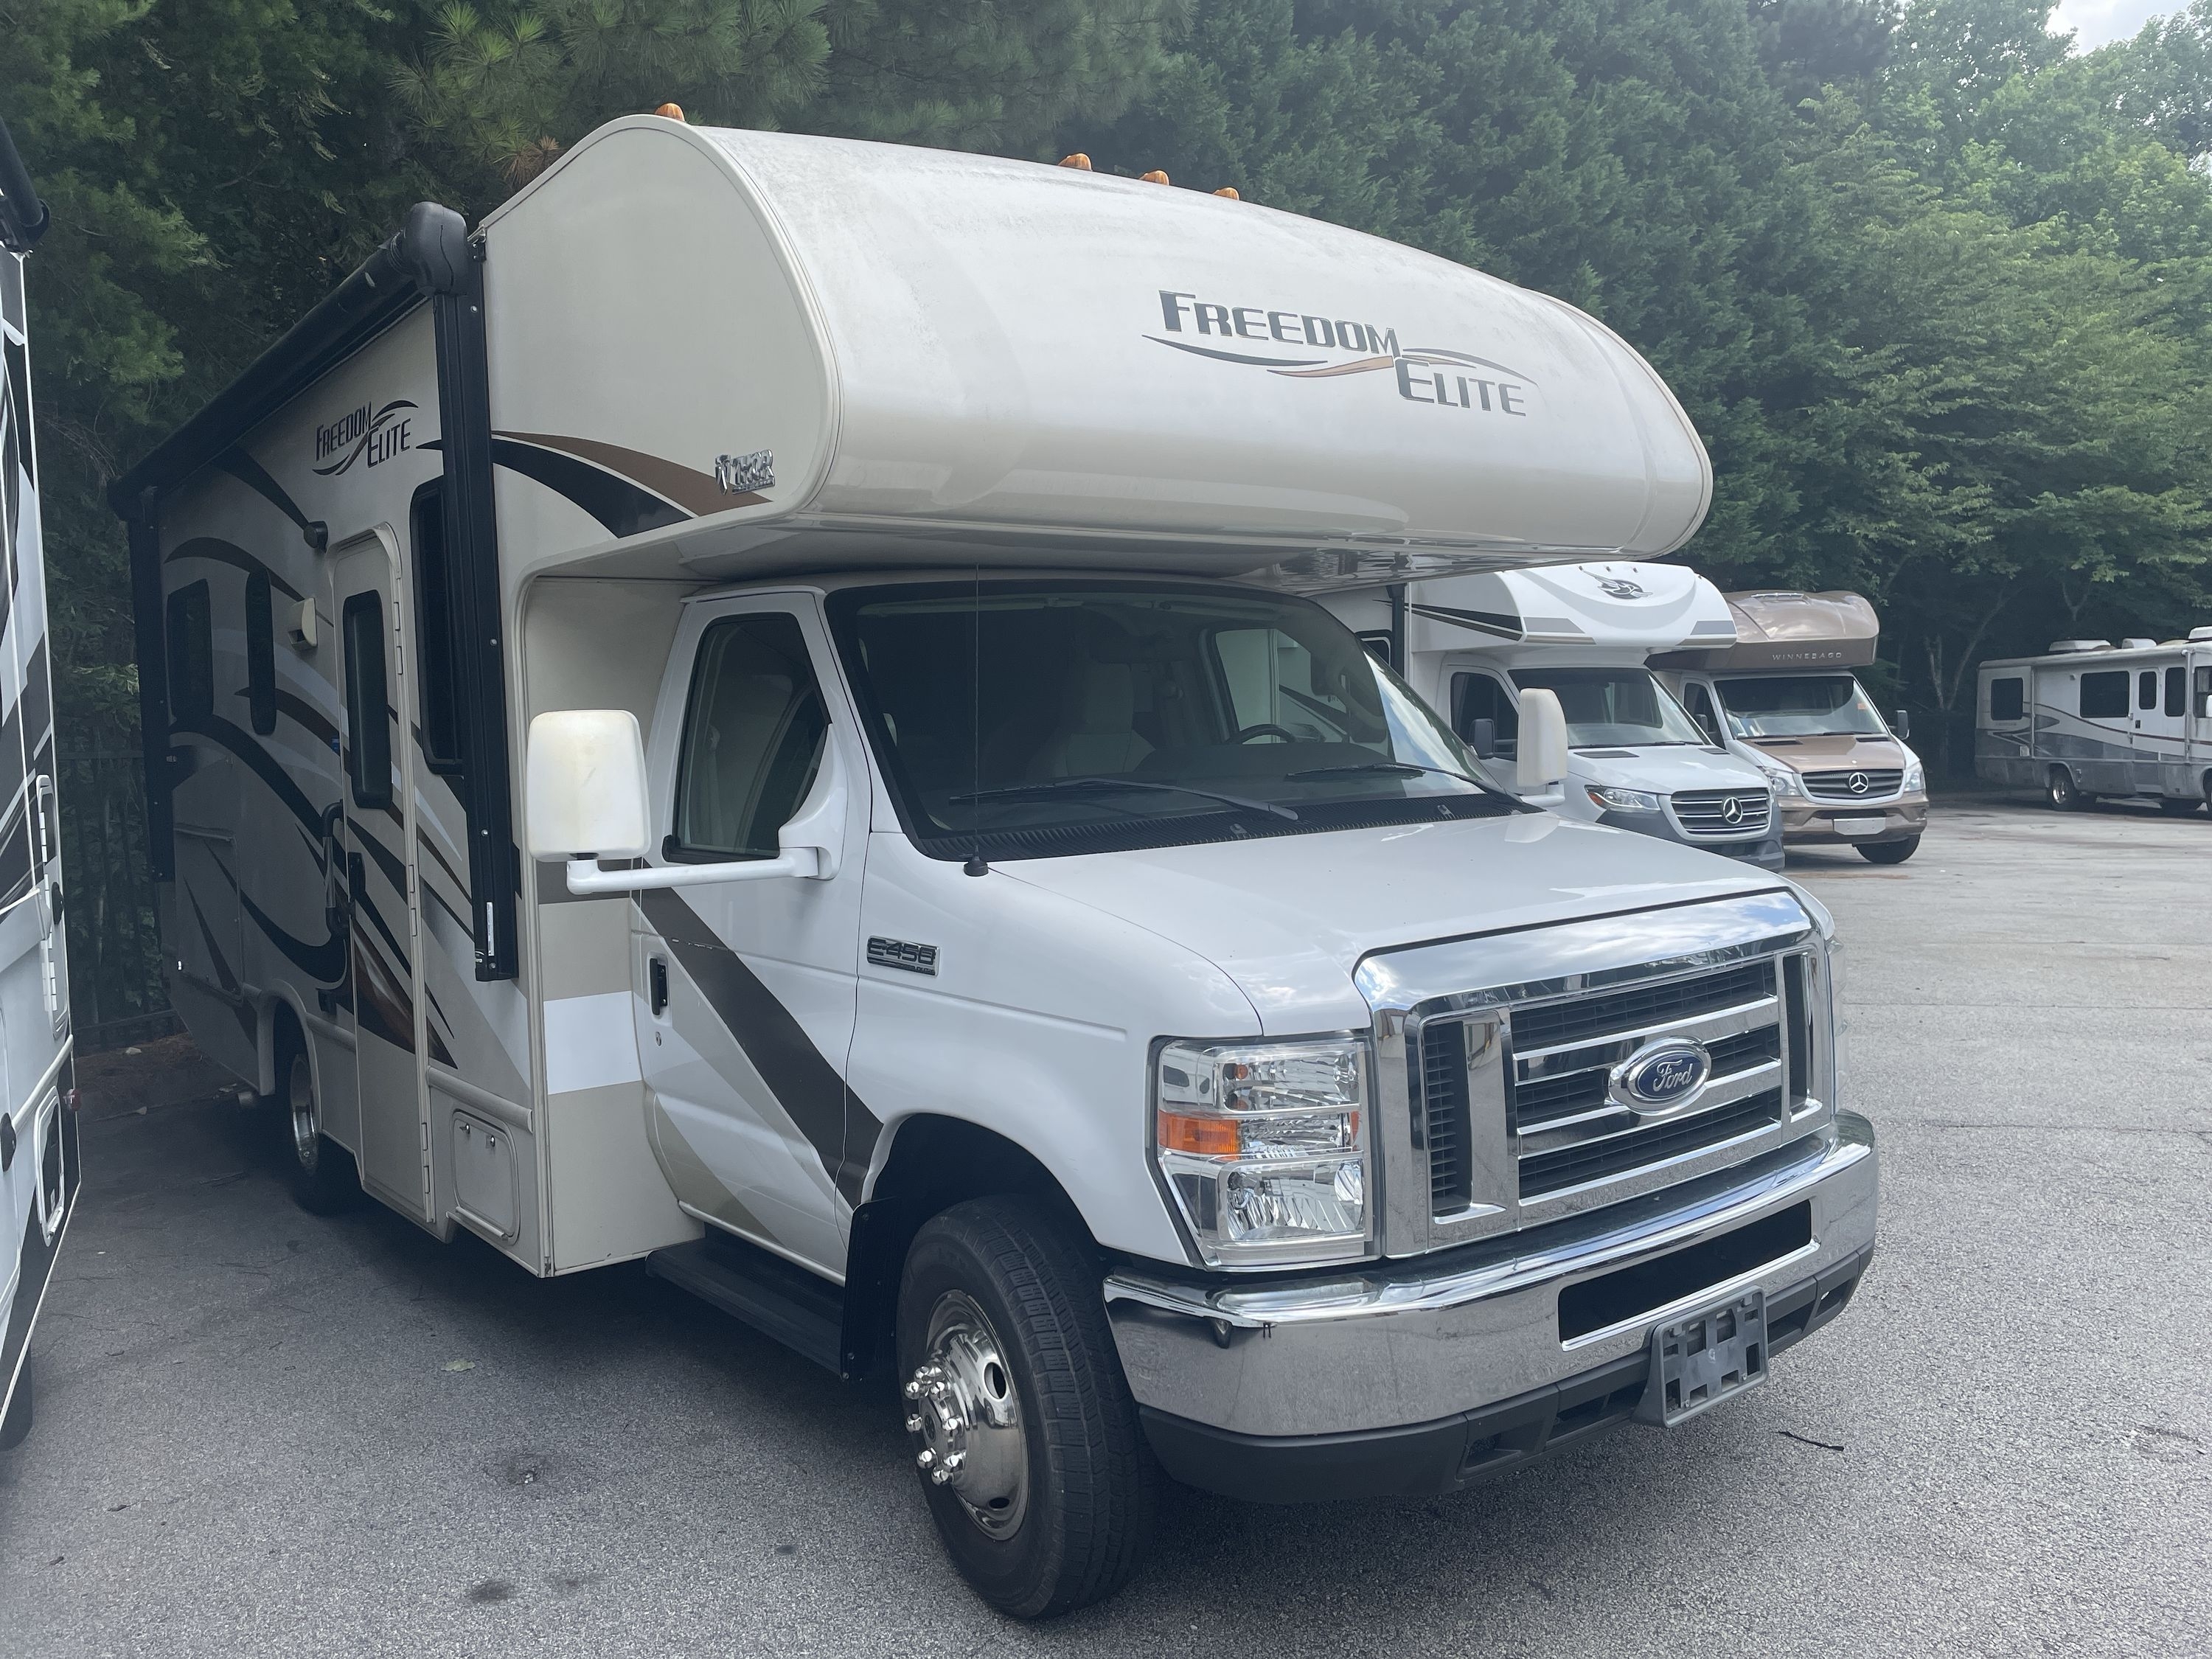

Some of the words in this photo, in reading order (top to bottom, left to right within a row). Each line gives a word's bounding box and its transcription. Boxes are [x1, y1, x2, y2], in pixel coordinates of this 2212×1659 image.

[1158, 290, 1401, 357] FREEDOM
[1394, 357, 1526, 417] ELITE
[316, 400, 372, 462] FREEDOM
[368, 417, 411, 468] ELITE
[1772, 652, 1843, 661] WINNEBAGO
[1652, 1059, 1694, 1092] Ford
